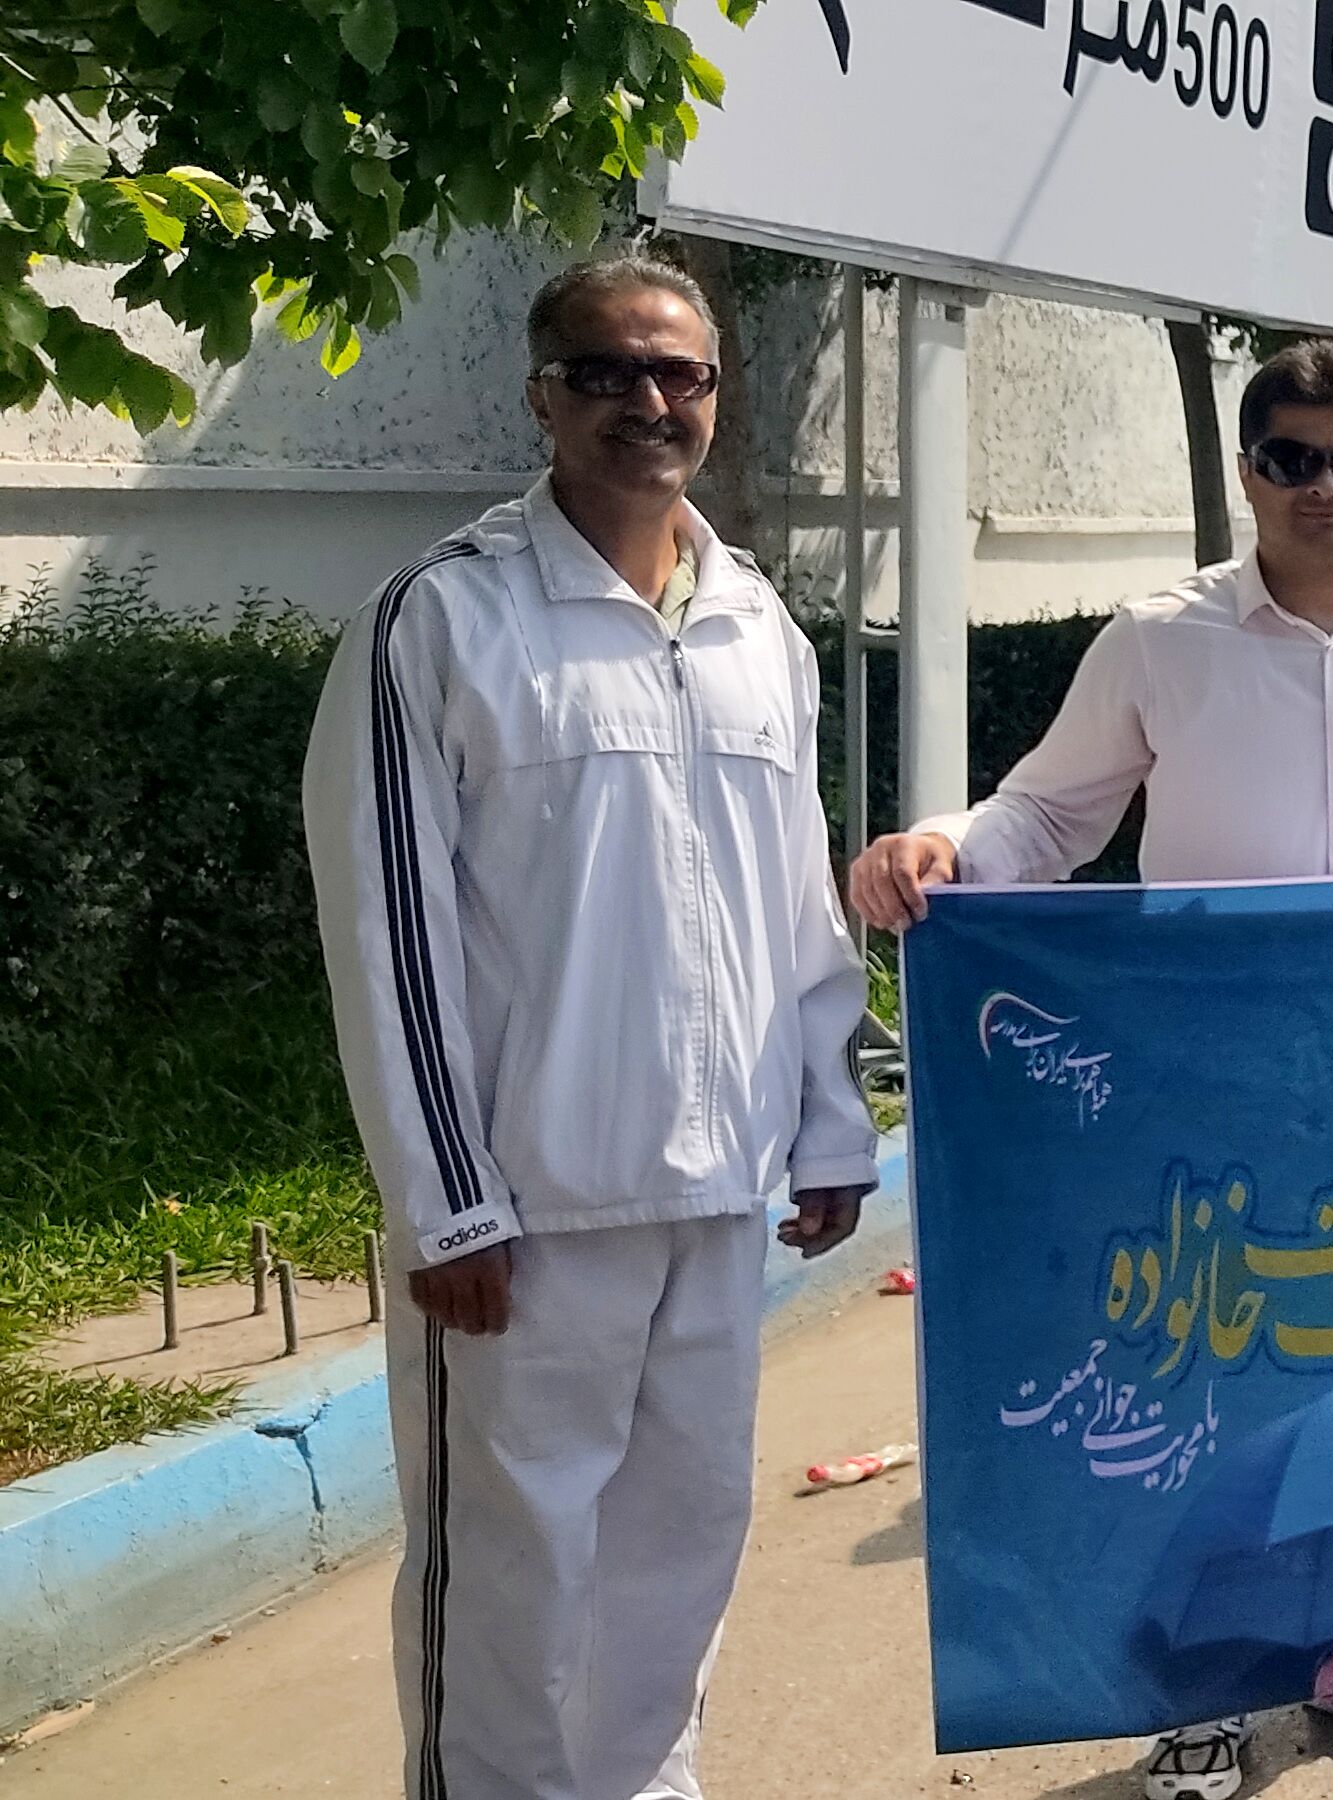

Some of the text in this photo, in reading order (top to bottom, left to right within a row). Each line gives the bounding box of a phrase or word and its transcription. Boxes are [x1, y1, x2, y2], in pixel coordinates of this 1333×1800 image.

[1174, 1, 1270, 130] 500
[438, 1218, 499, 1251] adidas
[1106, 1177, 1267, 1380] خانواده
